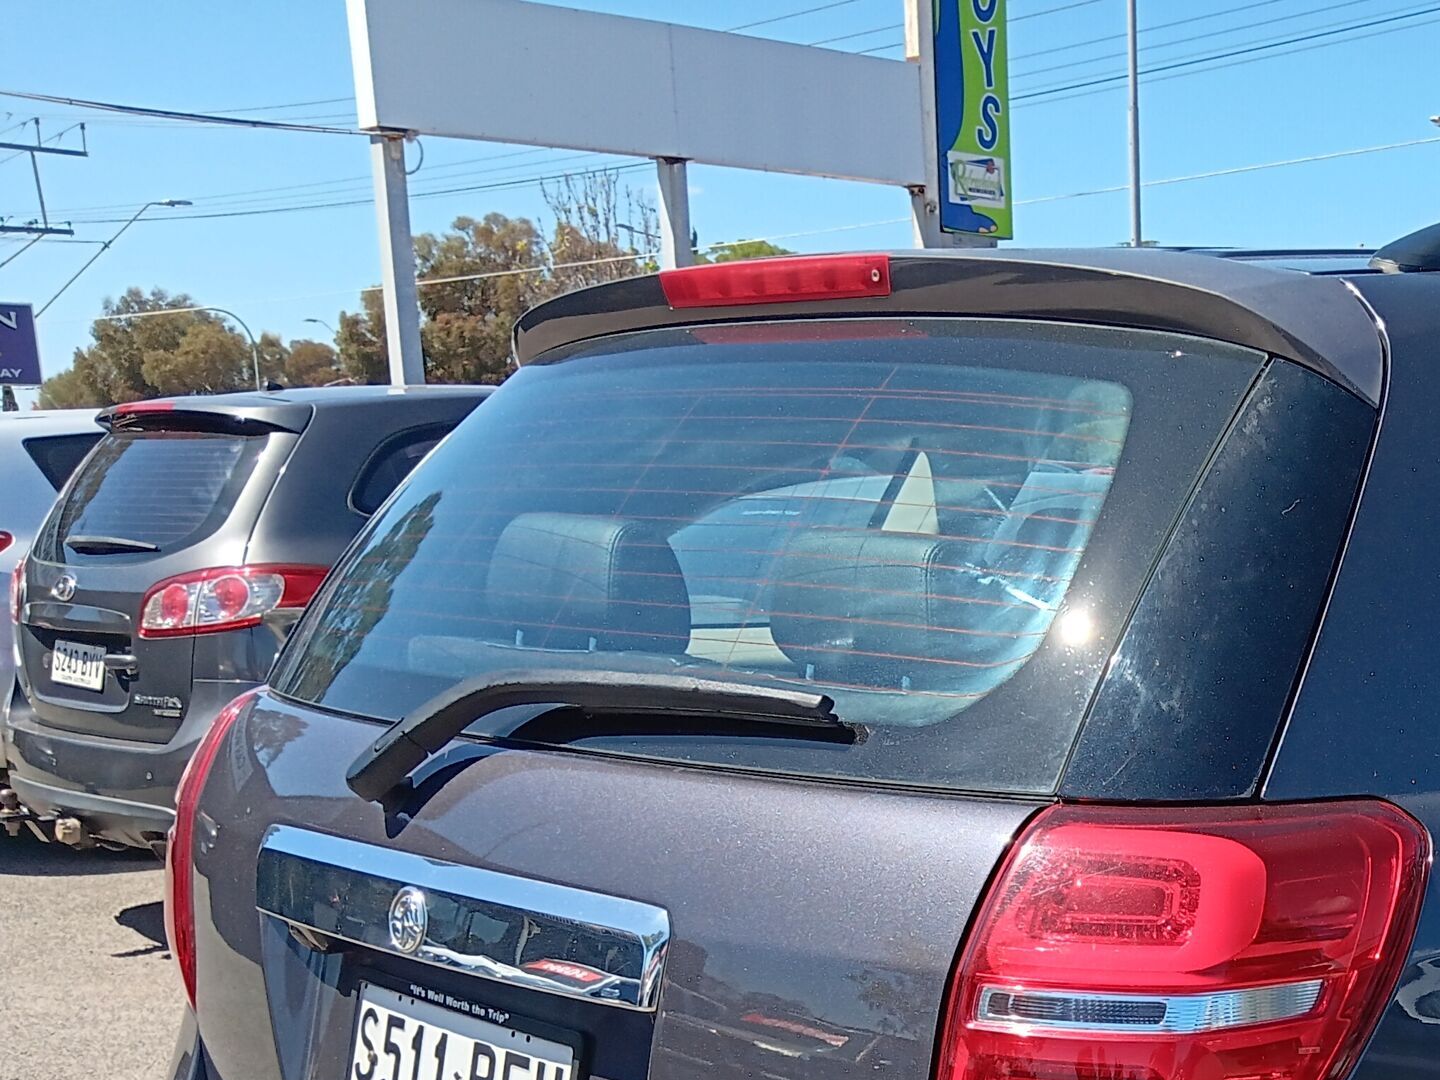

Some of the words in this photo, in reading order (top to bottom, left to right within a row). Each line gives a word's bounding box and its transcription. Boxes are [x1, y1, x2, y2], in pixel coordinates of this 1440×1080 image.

[427, 989, 445, 1004] Well
[445, 995, 471, 1012] Worth
[471, 1004, 486, 1017] the
